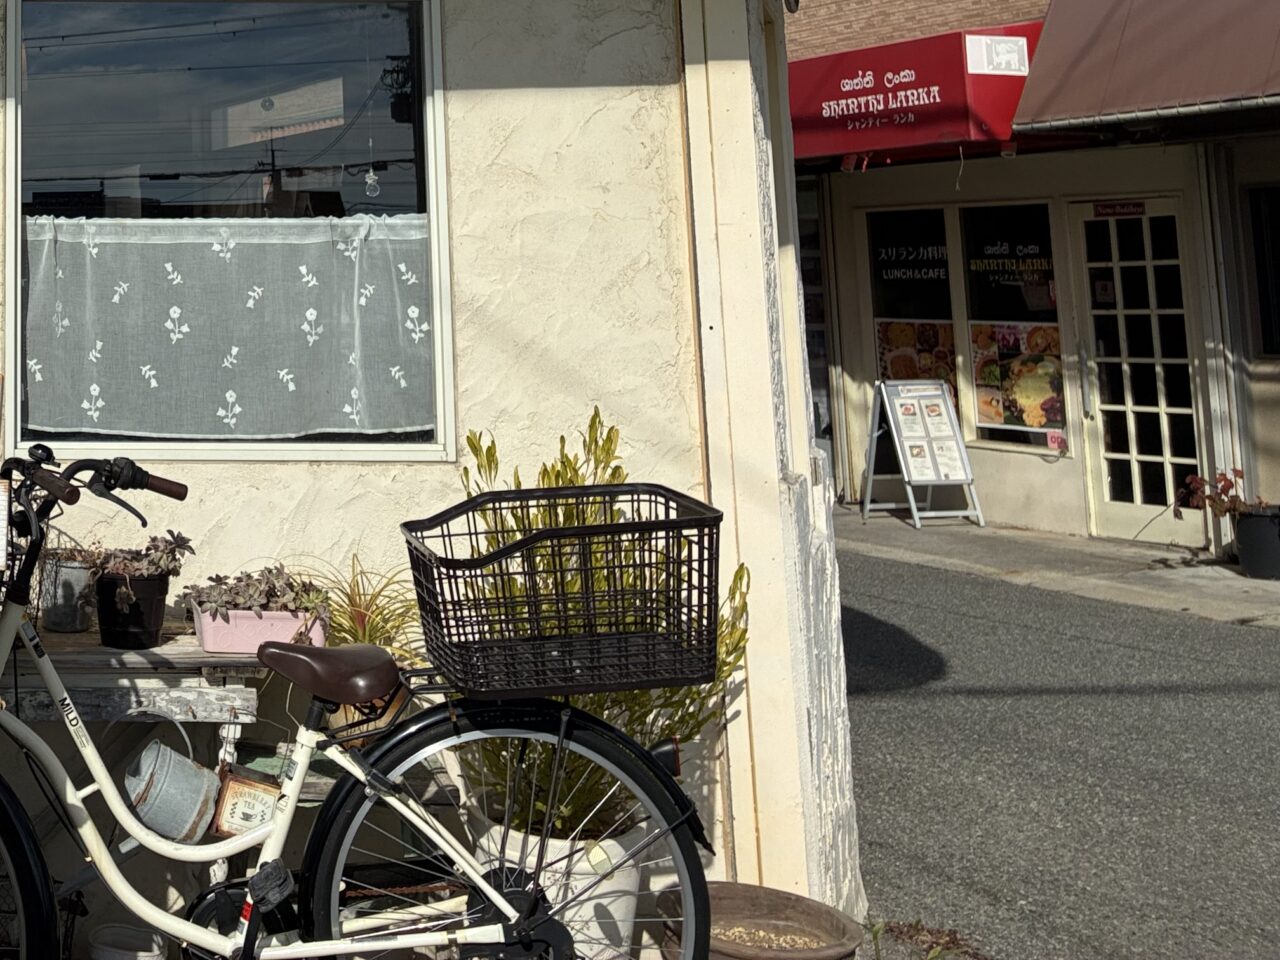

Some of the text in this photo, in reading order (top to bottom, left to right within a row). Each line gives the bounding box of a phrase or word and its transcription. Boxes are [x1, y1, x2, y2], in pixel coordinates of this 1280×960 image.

[888, 86, 941, 109] LANKA
[847, 117, 888, 130] シャンティー
[58, 697, 79, 727] MILD
[243, 800, 256, 810] TEA
